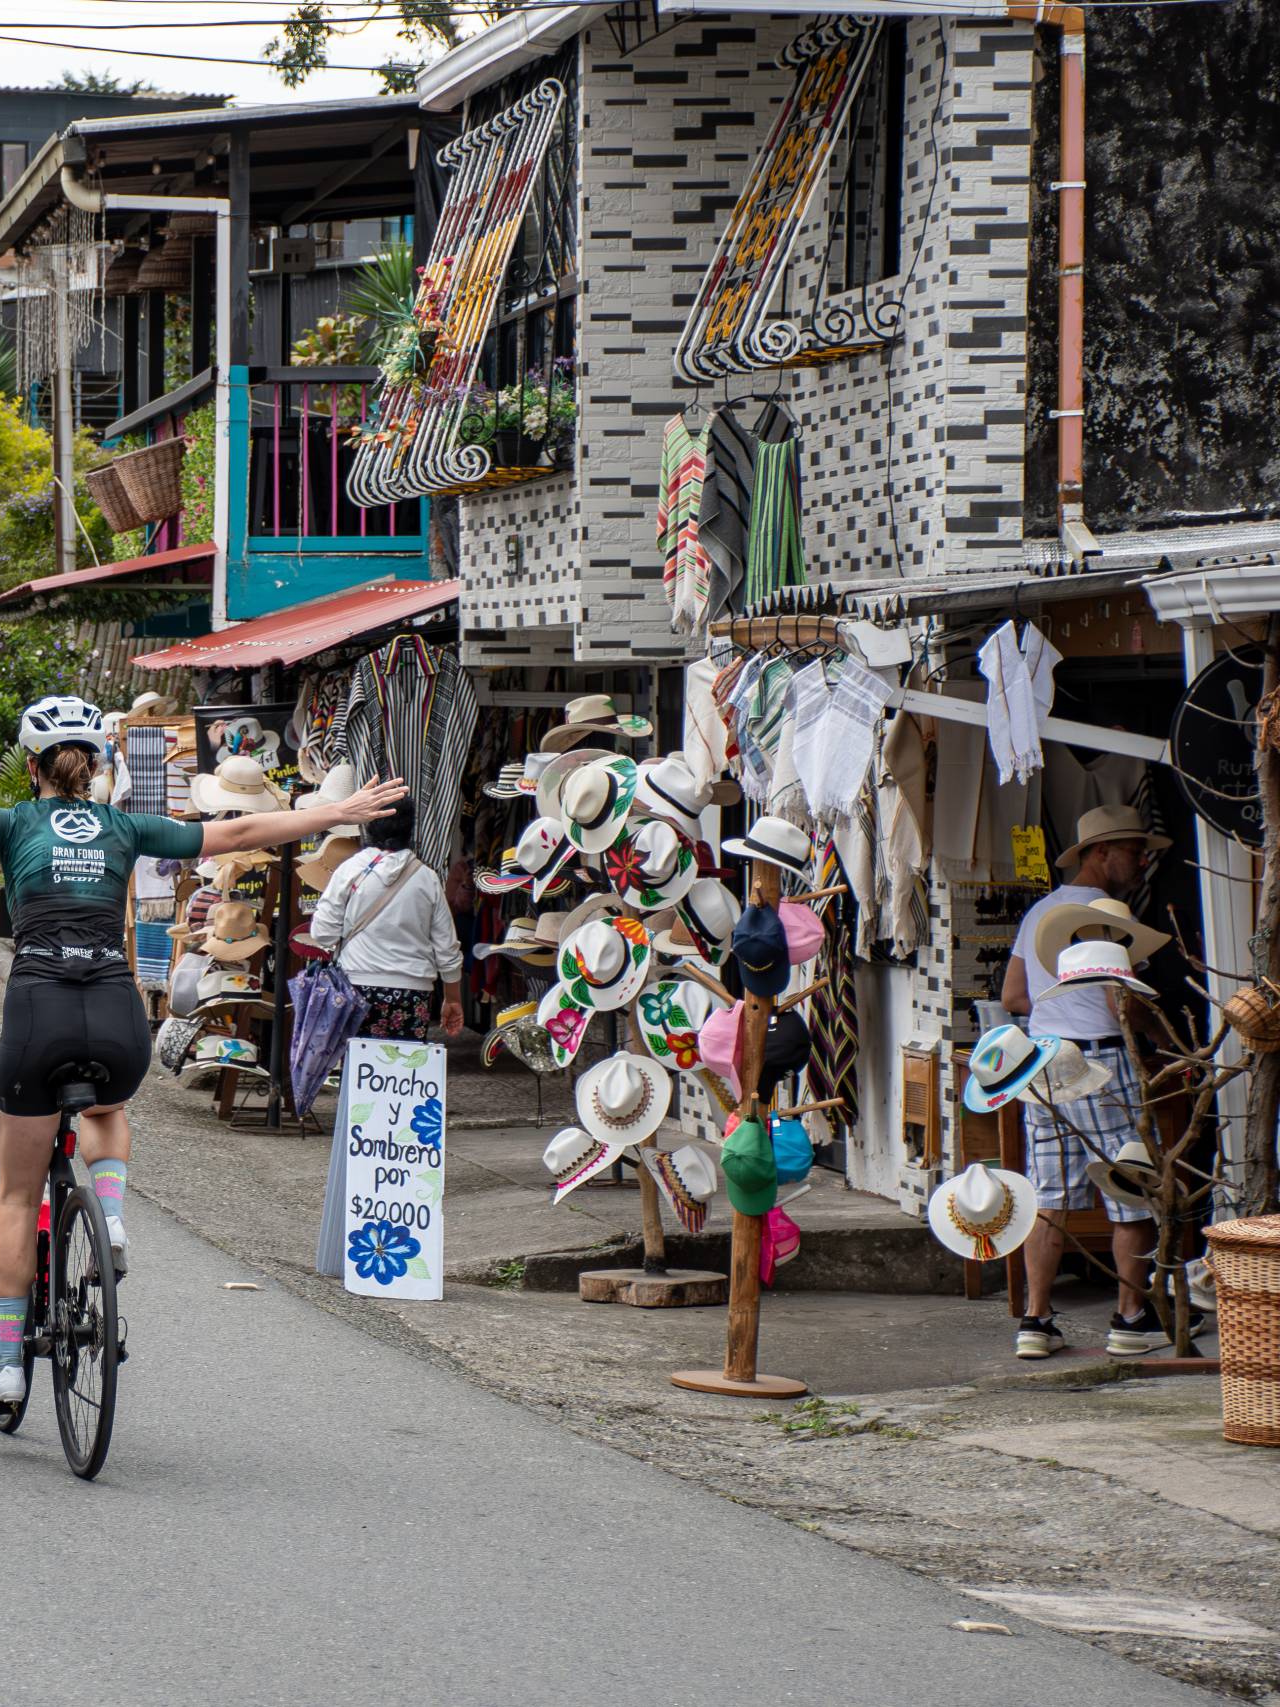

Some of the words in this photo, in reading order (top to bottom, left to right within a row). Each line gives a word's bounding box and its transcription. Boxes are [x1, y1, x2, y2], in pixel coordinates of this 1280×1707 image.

[52, 846, 75, 858] GRAN
[77, 848, 105, 860] FONDO
[62, 875, 101, 883] SCOTT
[357, 1062, 439, 1099] Poncho
[387, 1102, 402, 1126] y
[349, 1125, 442, 1169] Sombrero
[375, 1166, 411, 1194] por
